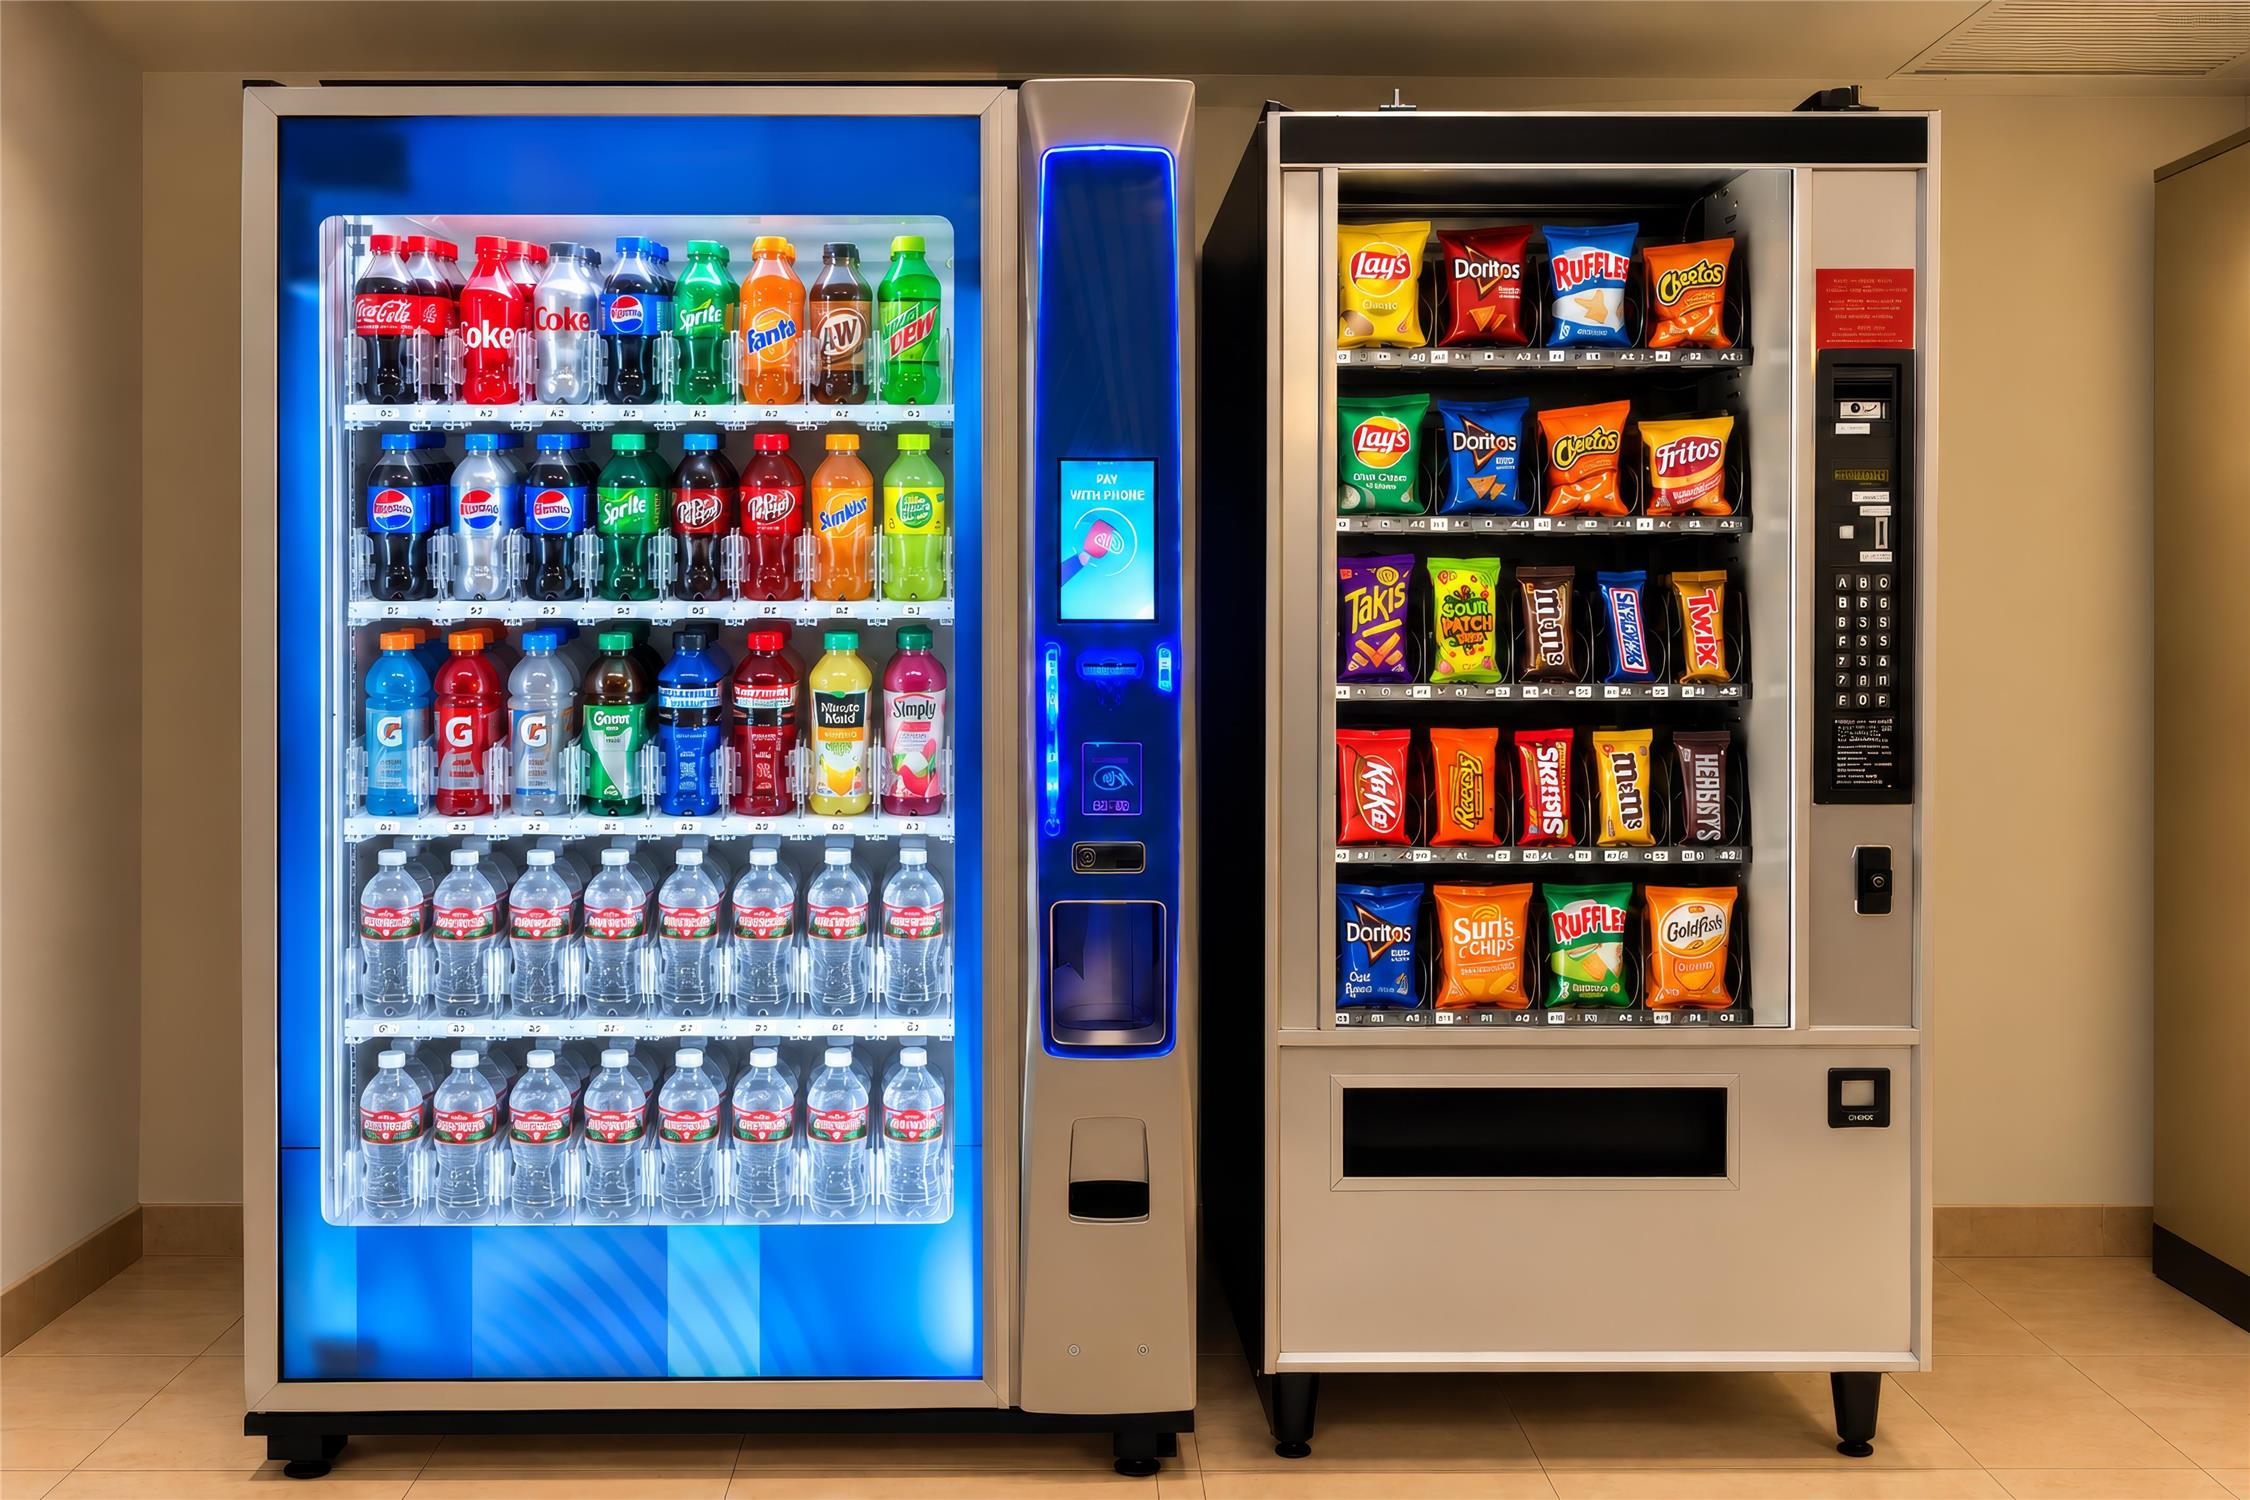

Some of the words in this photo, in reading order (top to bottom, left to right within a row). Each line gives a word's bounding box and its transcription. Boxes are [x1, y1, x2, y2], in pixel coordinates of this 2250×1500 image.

[1455, 259, 1520, 279] Doritos
[1658, 260, 1724, 303] Cheetos
[535, 306, 590, 331] Coke
[1453, 432, 1516, 450] Doritos
[1656, 440, 1720, 475] Fritos
[1071, 490, 1100, 500] WITH
[1104, 490, 1145, 500] PHONE
[1839, 578, 1846, 588] A
[1860, 578, 1867, 588] B
[1345, 582, 1406, 634] Takis
[1839, 598, 1847, 608] B
[1442, 615, 1492, 633] PATCH
[1688, 589, 1719, 669] TWIX
[377, 716, 402, 747] G
[445, 715, 473, 748] G
[520, 715, 547, 747] G
[1347, 922, 1411, 942] Doritos
